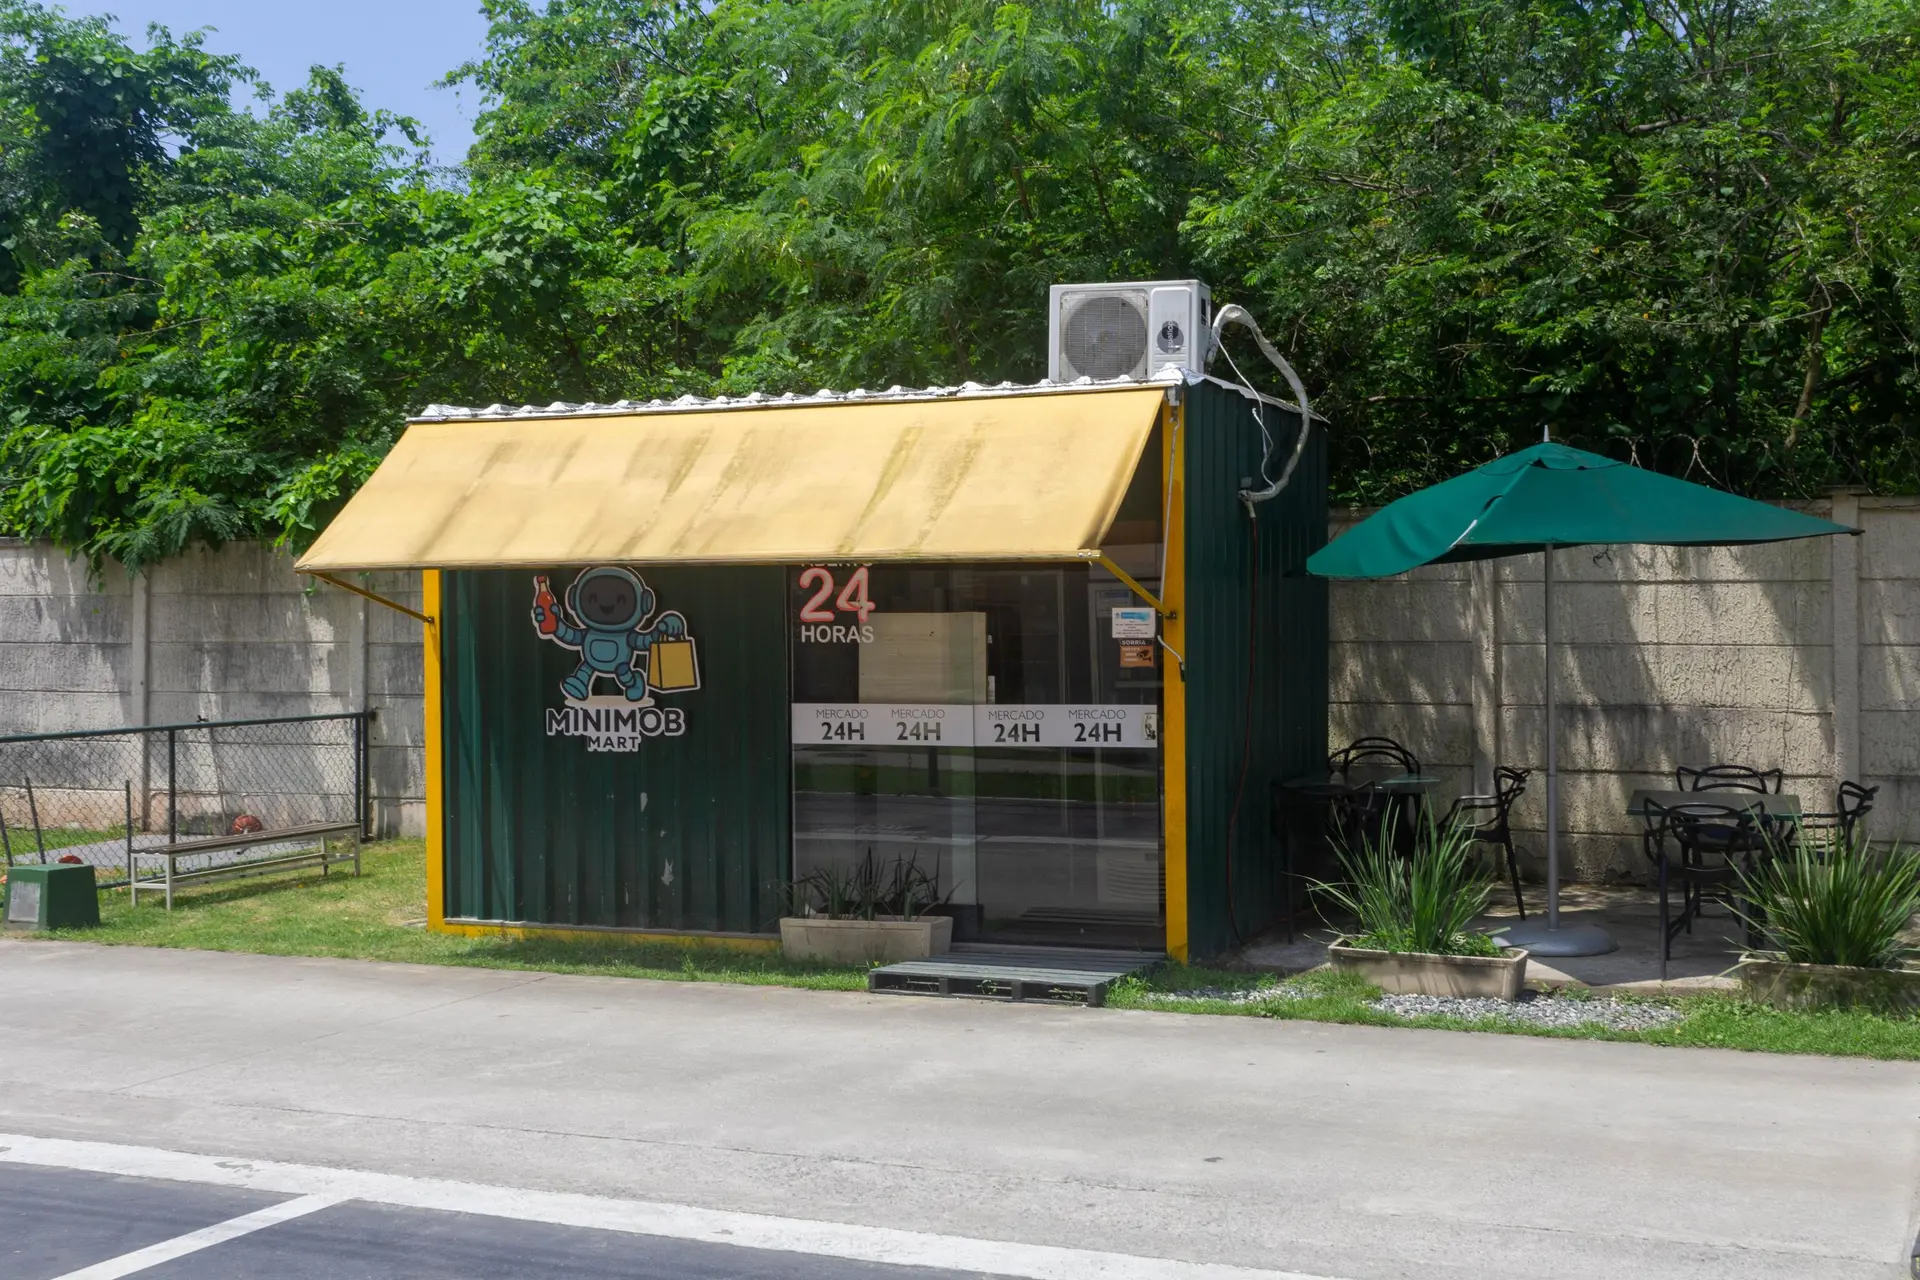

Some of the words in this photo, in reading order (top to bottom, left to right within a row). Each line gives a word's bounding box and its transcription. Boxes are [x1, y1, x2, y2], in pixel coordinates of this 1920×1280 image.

[799, 566, 877, 624] 24
[801, 625, 875, 644] HORAS
[547, 710, 684, 734] MINIMOB
[816, 709, 869, 719] MERCADO
[891, 708, 945, 719] MERCADO
[988, 710, 1045, 720] MERCADO
[1068, 709, 1126, 720] MERCADO
[821, 722, 865, 741] 24H
[896, 722, 942, 741] 24H
[993, 723, 1041, 743] 24H
[1074, 723, 1122, 742] 24H
[588, 736, 639, 749] MART
